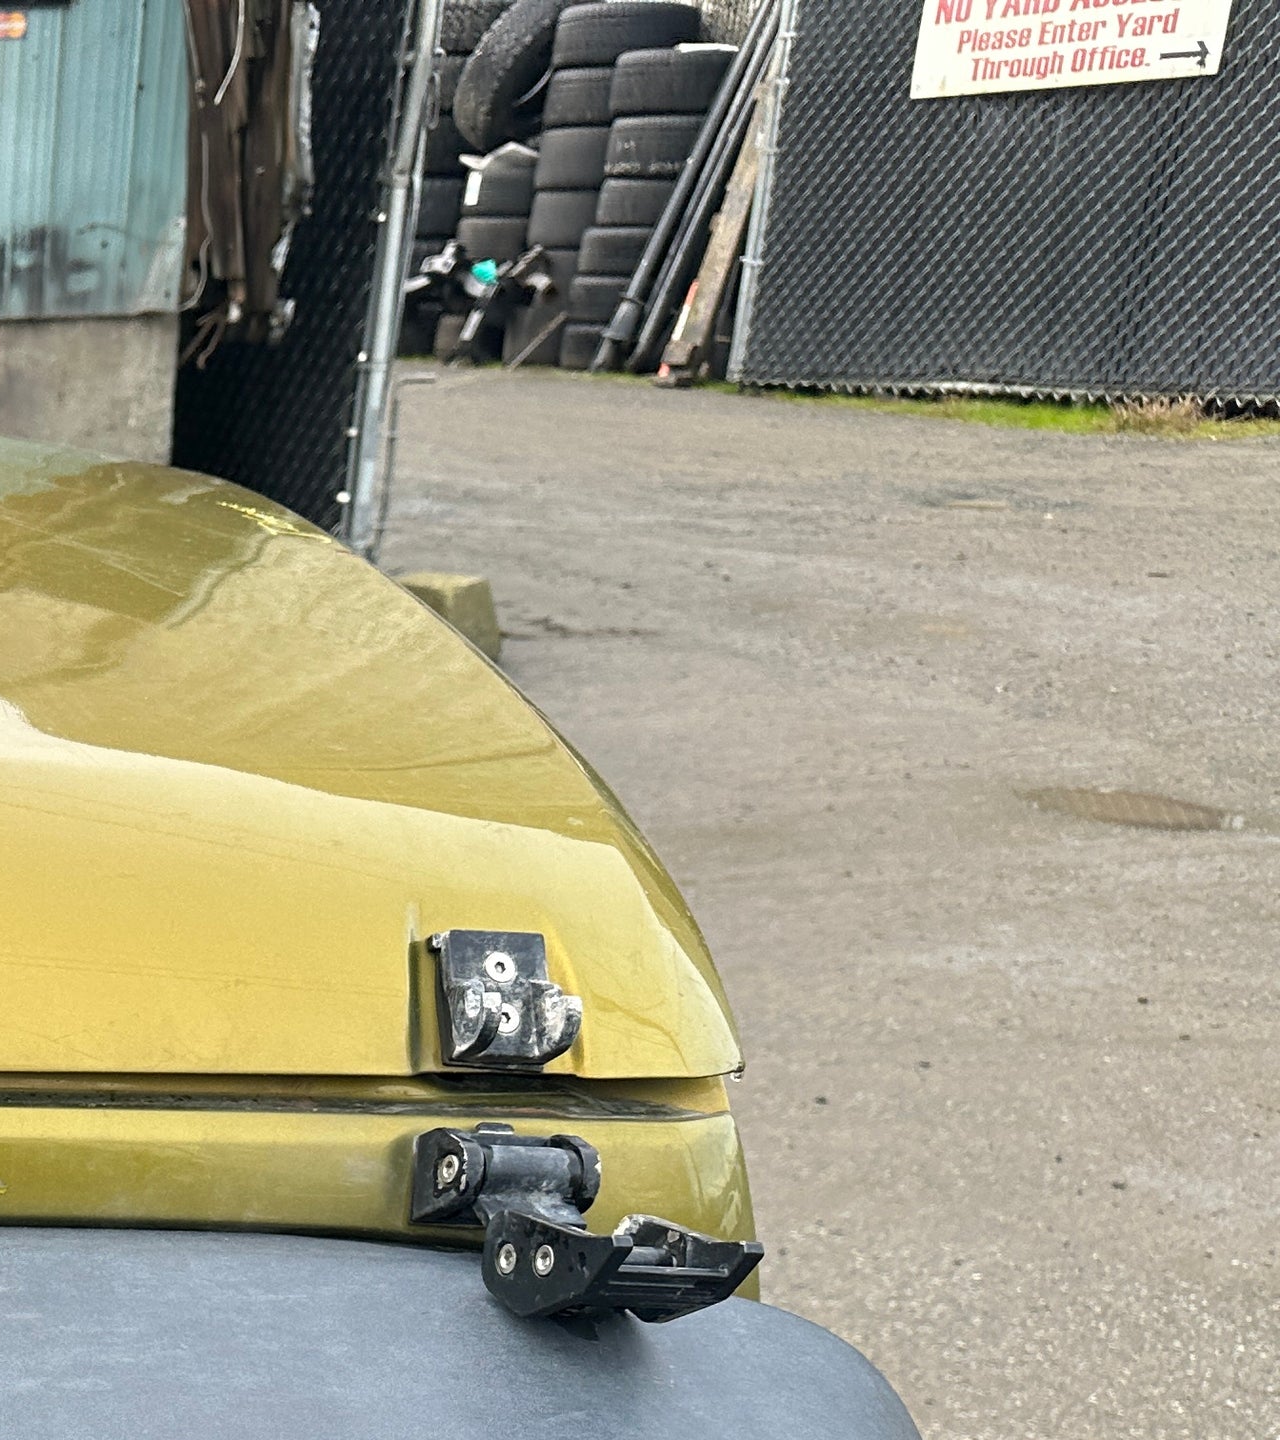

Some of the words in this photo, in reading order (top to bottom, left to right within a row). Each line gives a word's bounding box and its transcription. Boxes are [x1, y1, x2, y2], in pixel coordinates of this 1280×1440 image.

[935, 0, 972, 24] NO
[957, 26, 1032, 53] Please
[1039, 19, 1107, 45] Enter
[1117, 8, 1181, 37] Yard
[971, 49, 1065, 81] Through
[1070, 46, 1151, 73] Office.
